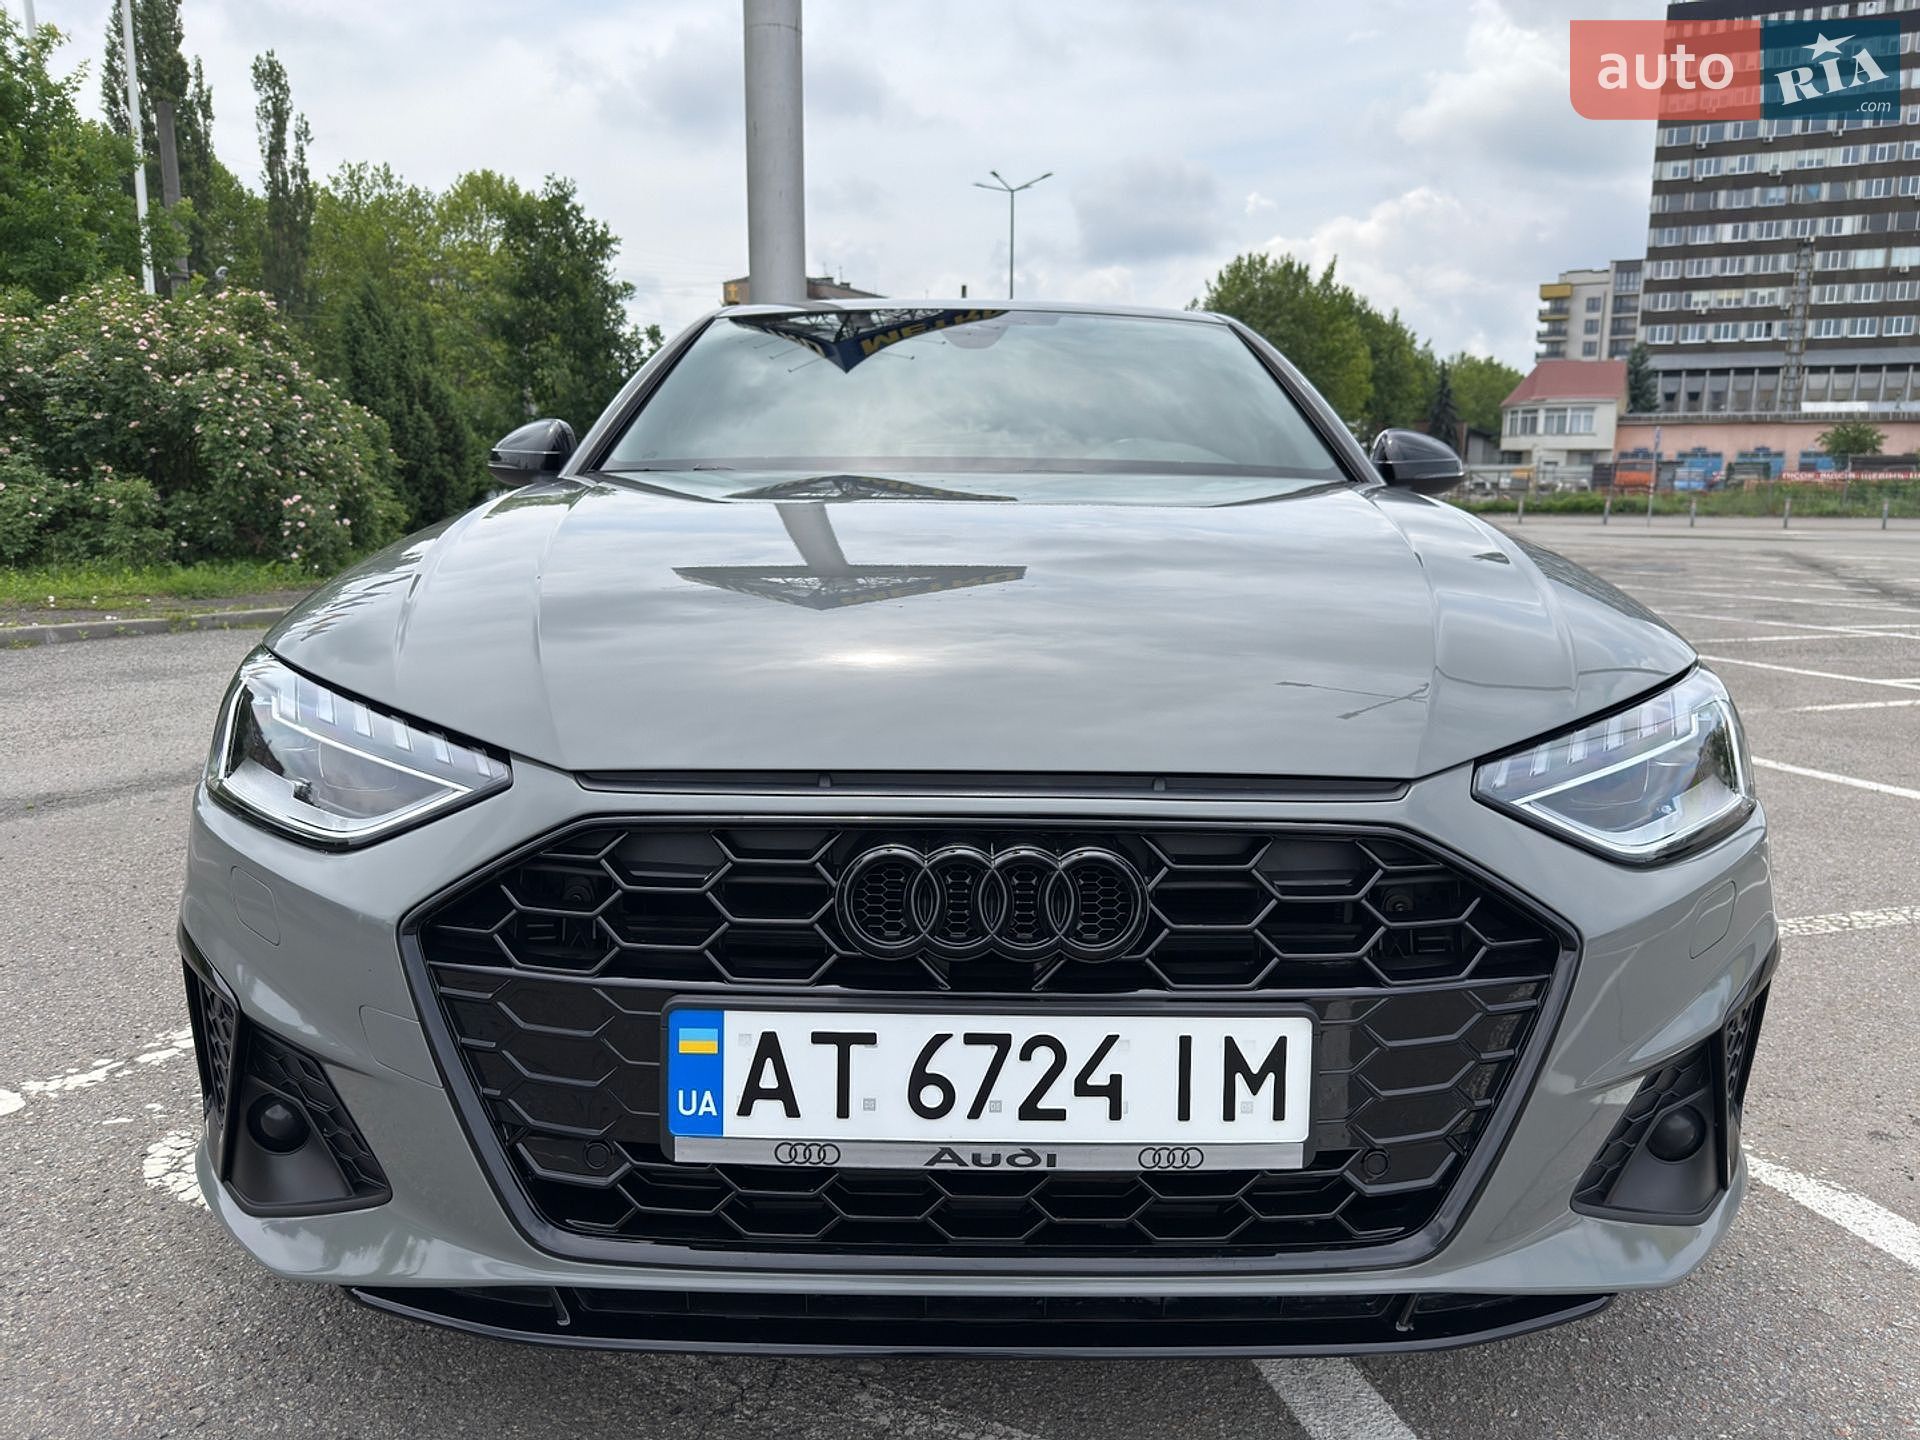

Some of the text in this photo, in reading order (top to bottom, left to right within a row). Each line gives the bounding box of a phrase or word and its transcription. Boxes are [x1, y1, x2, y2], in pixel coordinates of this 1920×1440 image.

[736, 1031, 1288, 1122] AT 6724 IM
[678, 1090, 718, 1116] UA
[924, 1147, 1057, 1168] Audi
